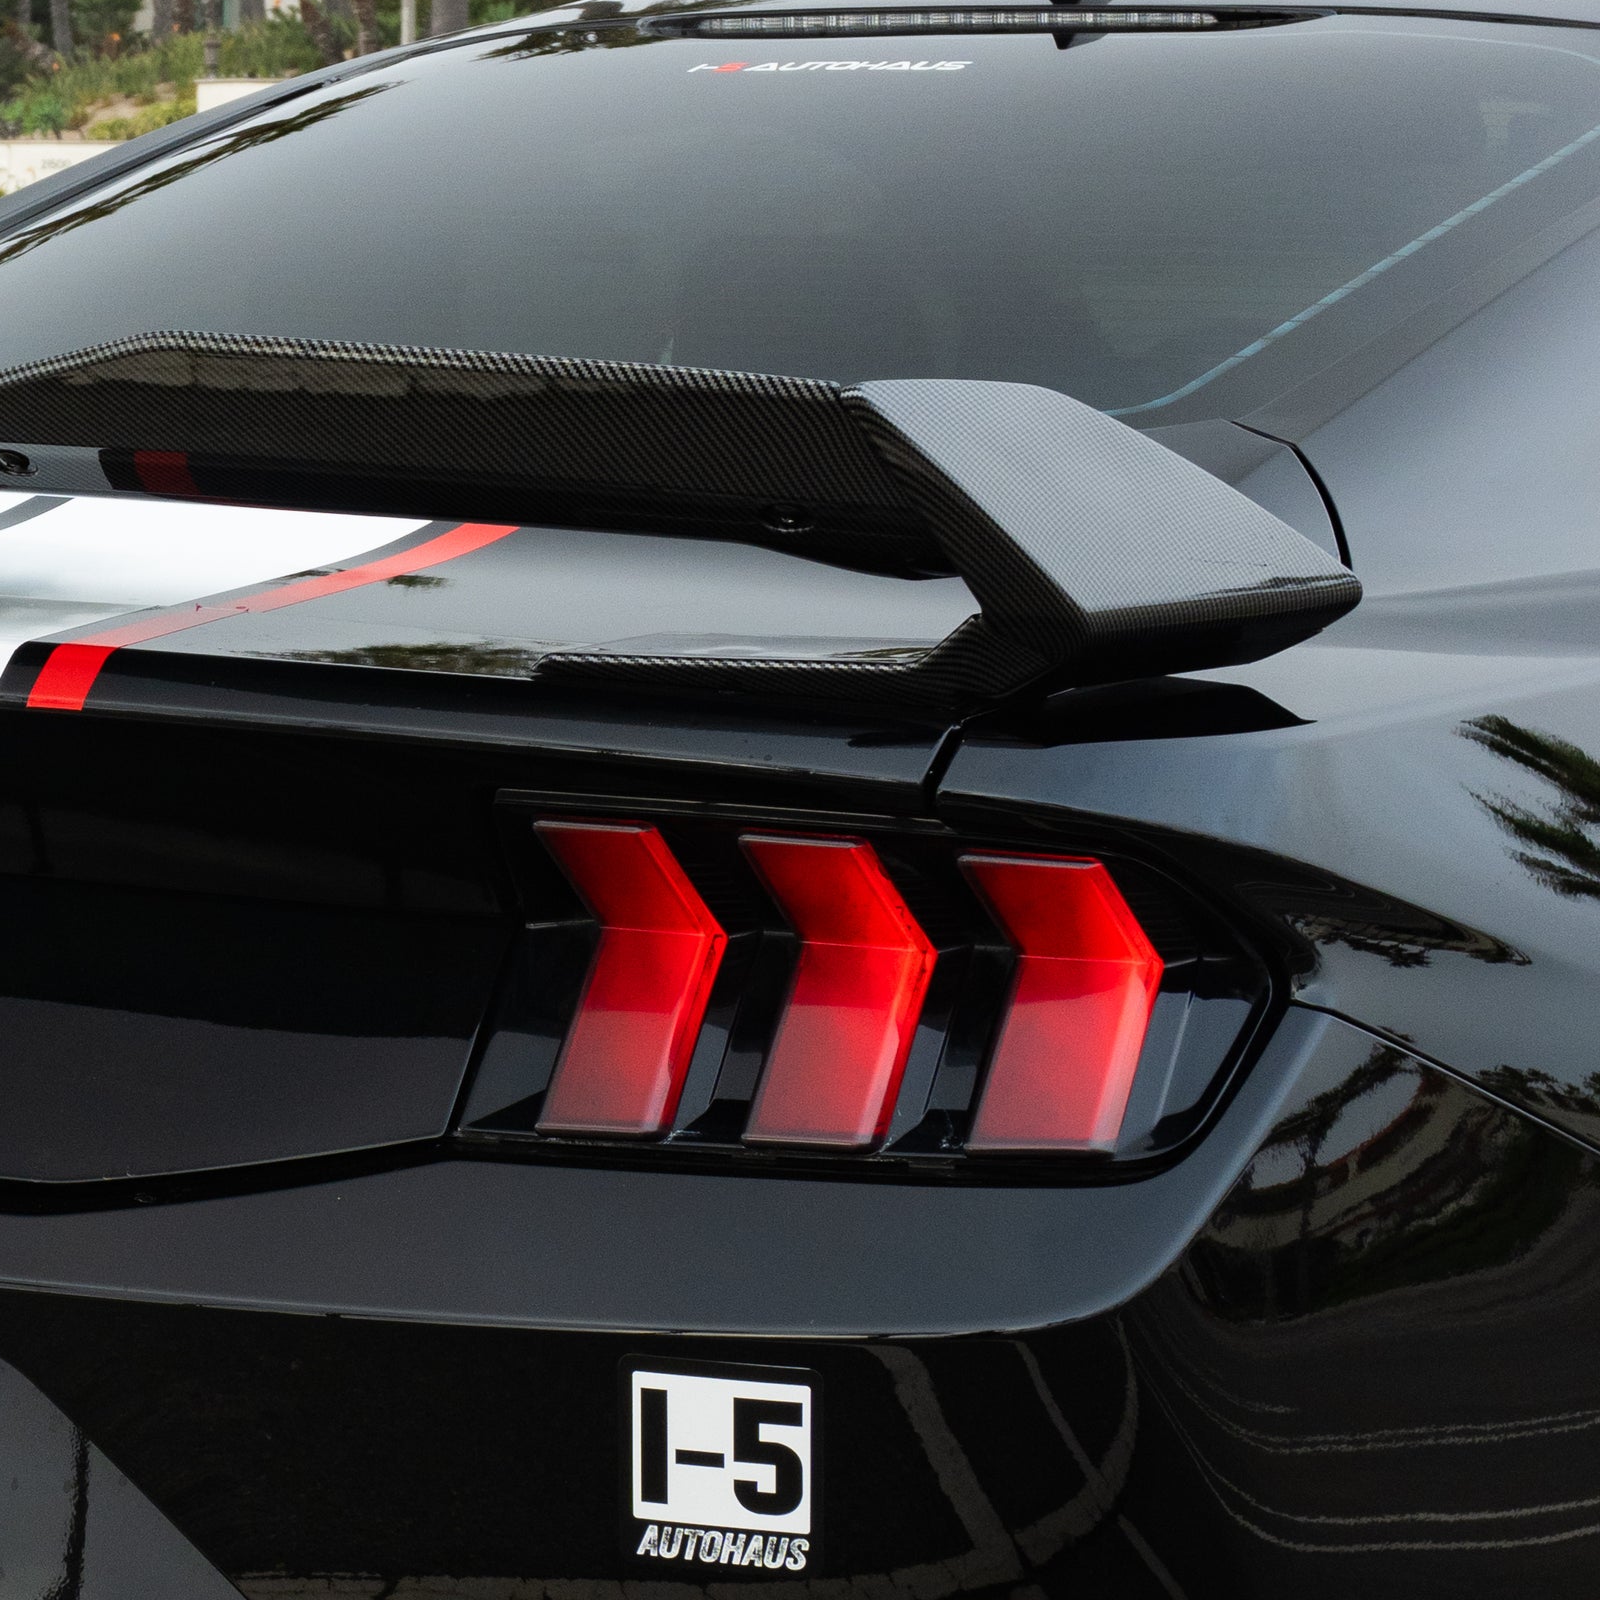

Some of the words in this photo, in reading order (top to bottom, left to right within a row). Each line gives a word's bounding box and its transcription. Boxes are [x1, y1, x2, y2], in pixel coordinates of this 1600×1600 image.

[741, 60, 974, 72] AUTOHAUS
[640, 1387, 804, 1516] I-5
[636, 1524, 810, 1572] AUTOHAUS
